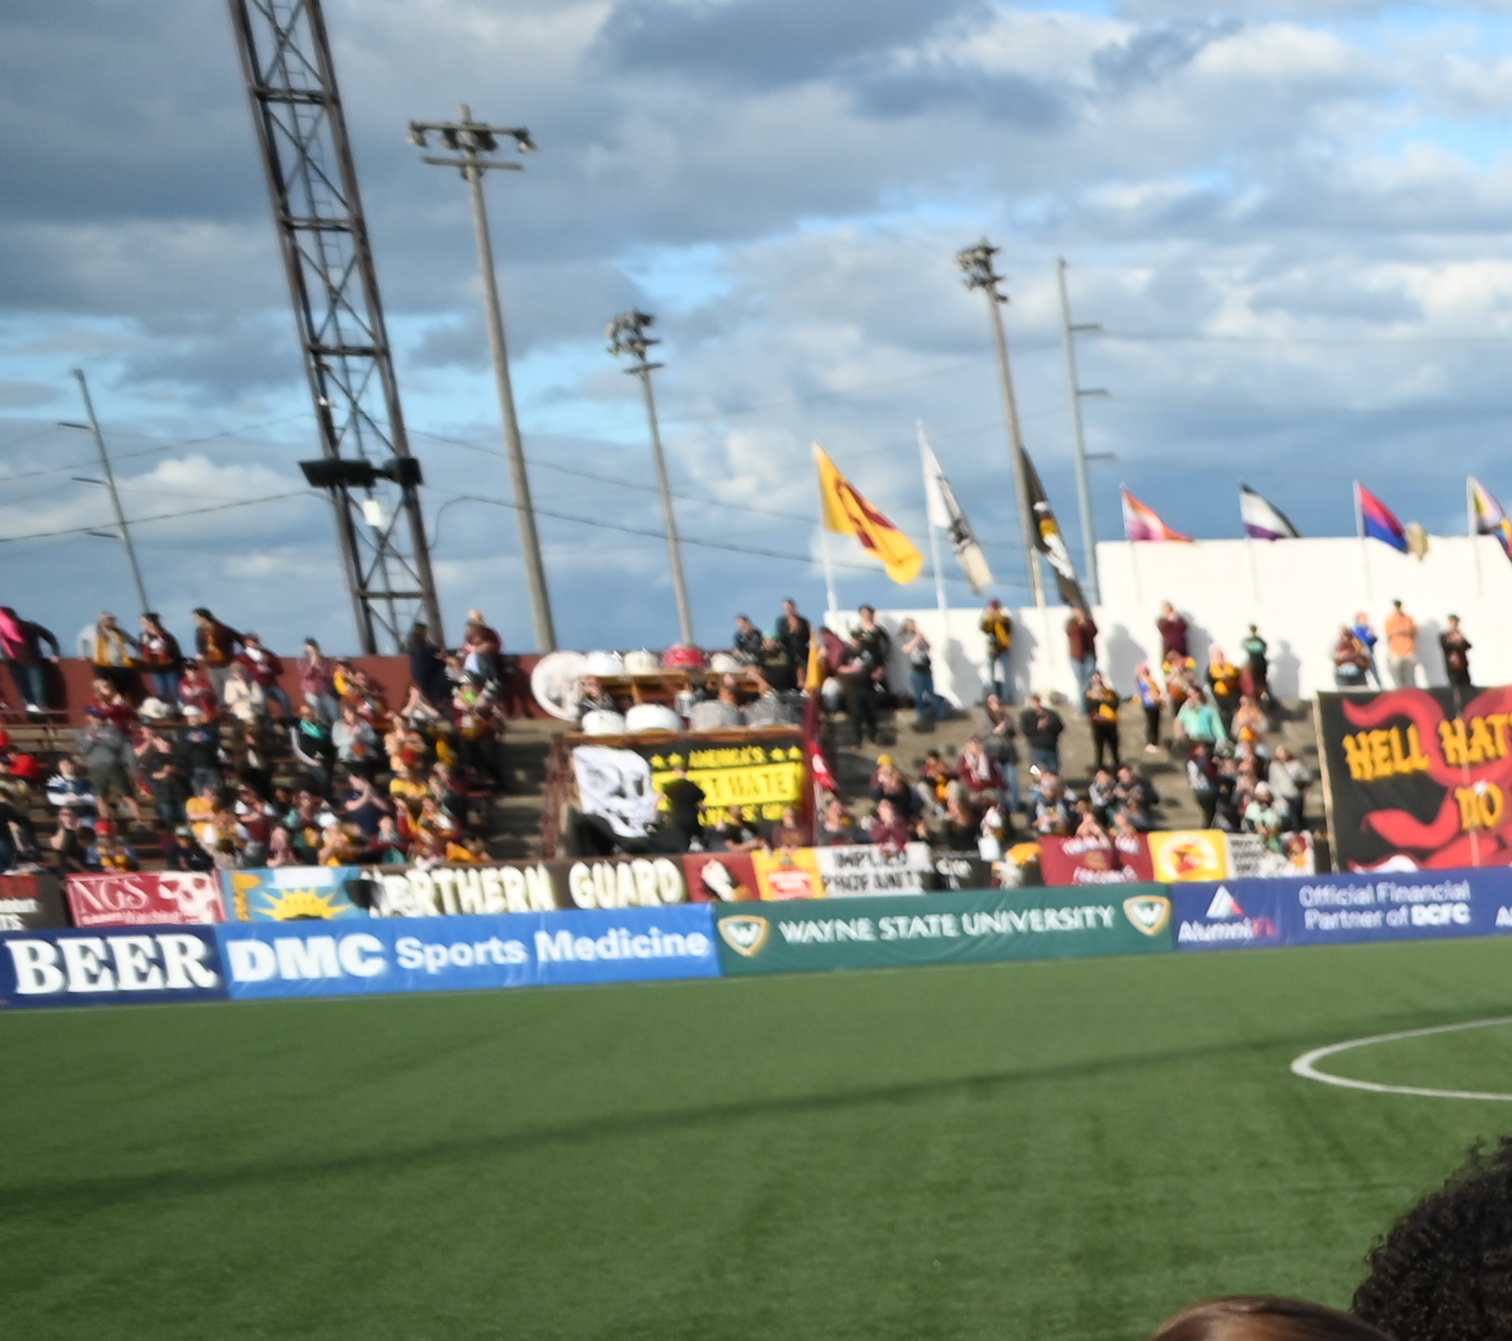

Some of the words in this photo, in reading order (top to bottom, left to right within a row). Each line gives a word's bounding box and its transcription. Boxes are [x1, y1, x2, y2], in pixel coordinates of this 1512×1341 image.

[1342, 725, 1431, 781] HELL
[569, 858, 684, 909] GUARD
[1299, 883, 1375, 907] Official
[1376, 879, 1471, 903] Financial
[779, 918, 877, 943] WAYNE
[879, 914, 960, 939] STATE
[962, 904, 1116, 936] UNIVERSITY
[1304, 907, 1385, 930] Partner
[1386, 905, 1408, 927] of
[1410, 902, 1472, 926] DCFC
[5, 934, 217, 994] BEER
[226, 933, 386, 982] DMC
[395, 936, 528, 974] Sports
[534, 926, 710, 961] Medicine
